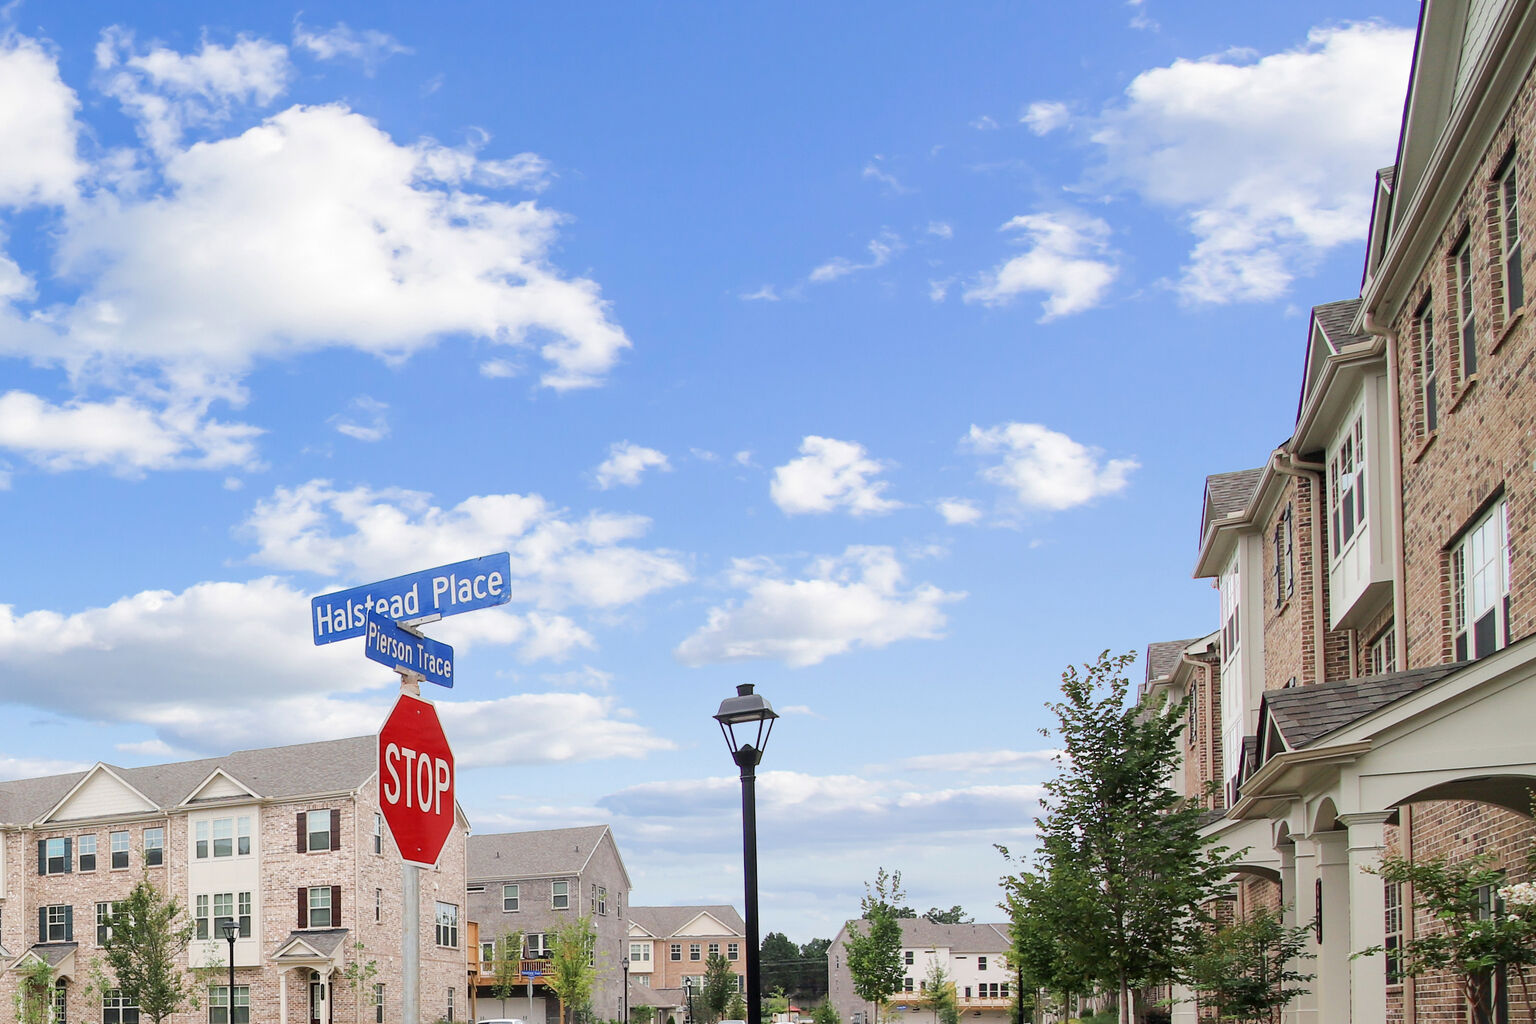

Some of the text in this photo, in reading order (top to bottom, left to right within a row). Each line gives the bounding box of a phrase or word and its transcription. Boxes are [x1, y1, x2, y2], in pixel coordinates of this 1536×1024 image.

[316, 571, 504, 636] Halstead Place
[368, 621, 452, 678] Pierson Trace
[383, 742, 452, 815] STOP
